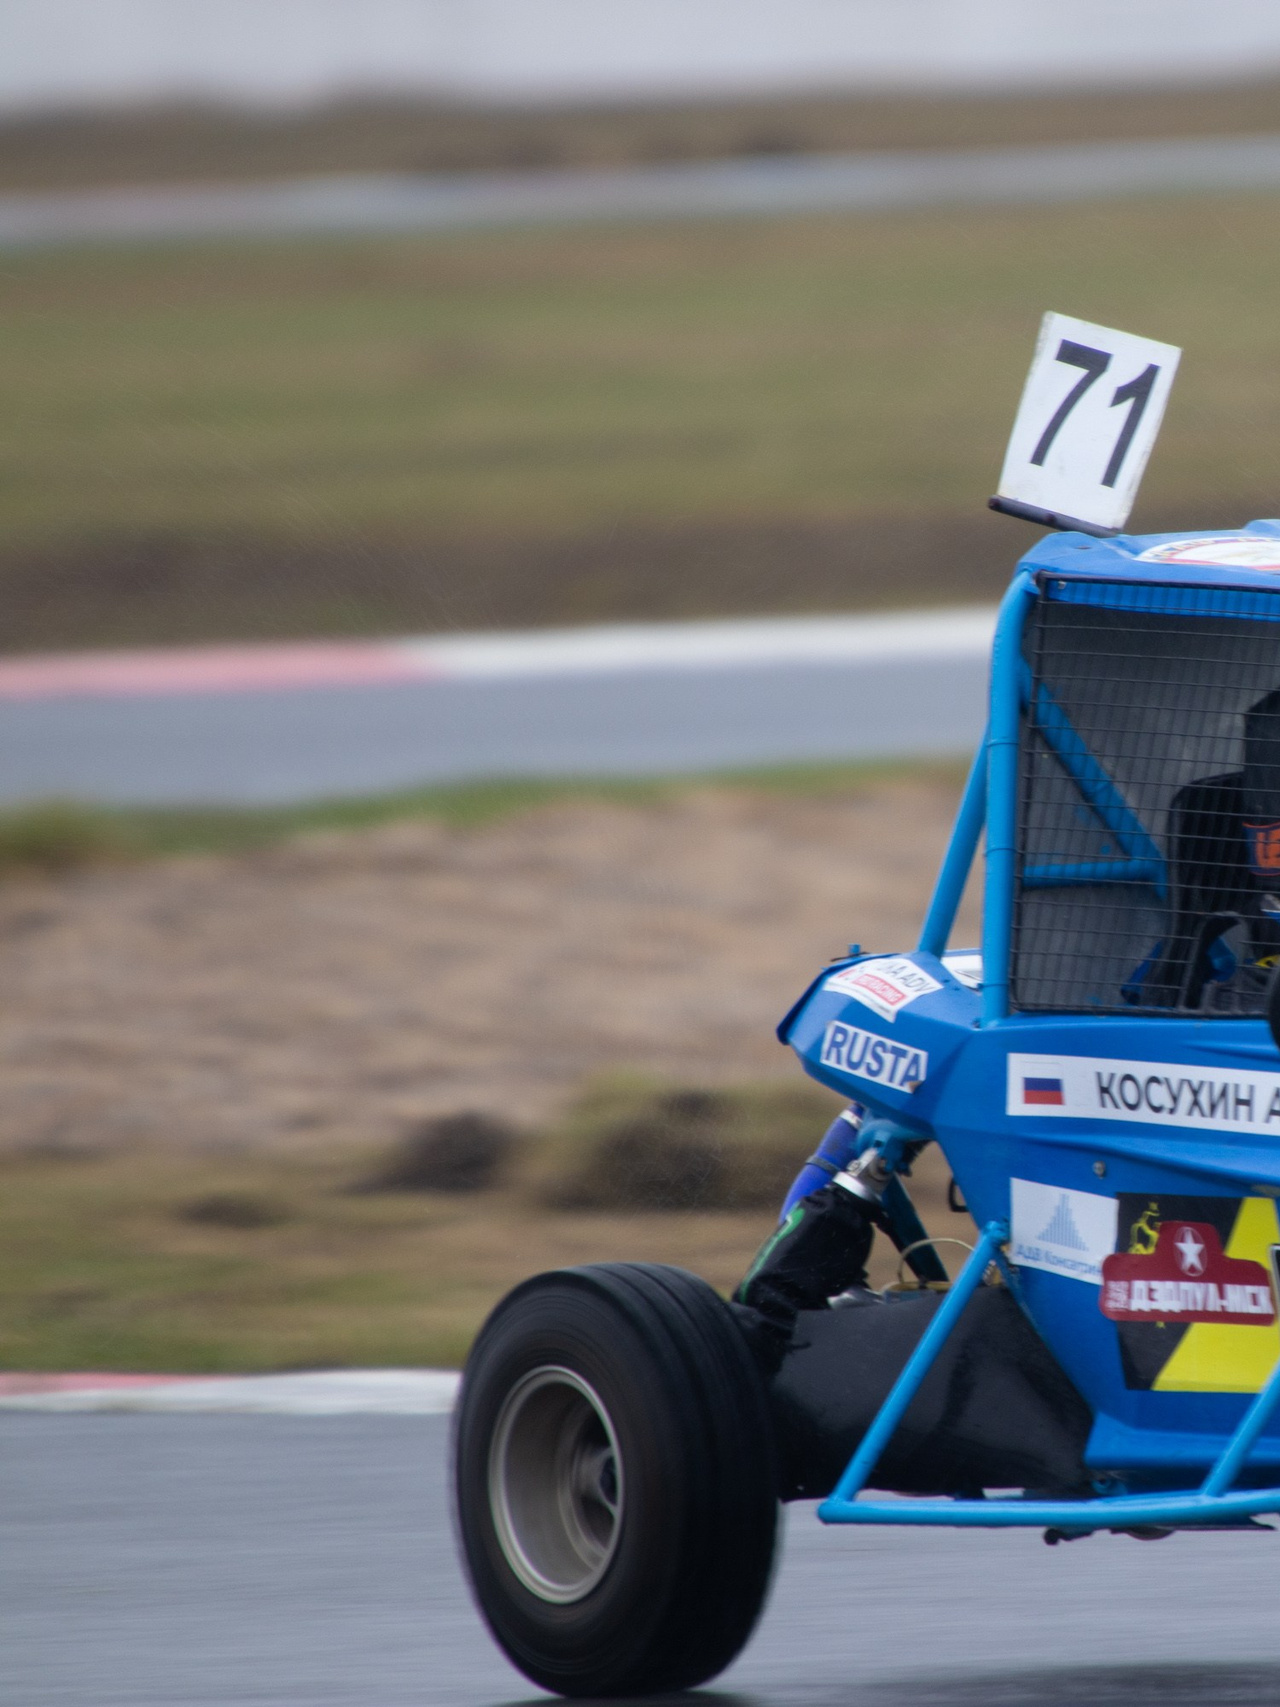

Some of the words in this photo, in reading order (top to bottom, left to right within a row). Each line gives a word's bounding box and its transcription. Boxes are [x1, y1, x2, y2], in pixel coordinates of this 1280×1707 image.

[1029, 338, 1161, 489] 71
[824, 1025, 923, 1088] RUSTA
[1095, 1071, 1256, 1123] КОСУХИН
